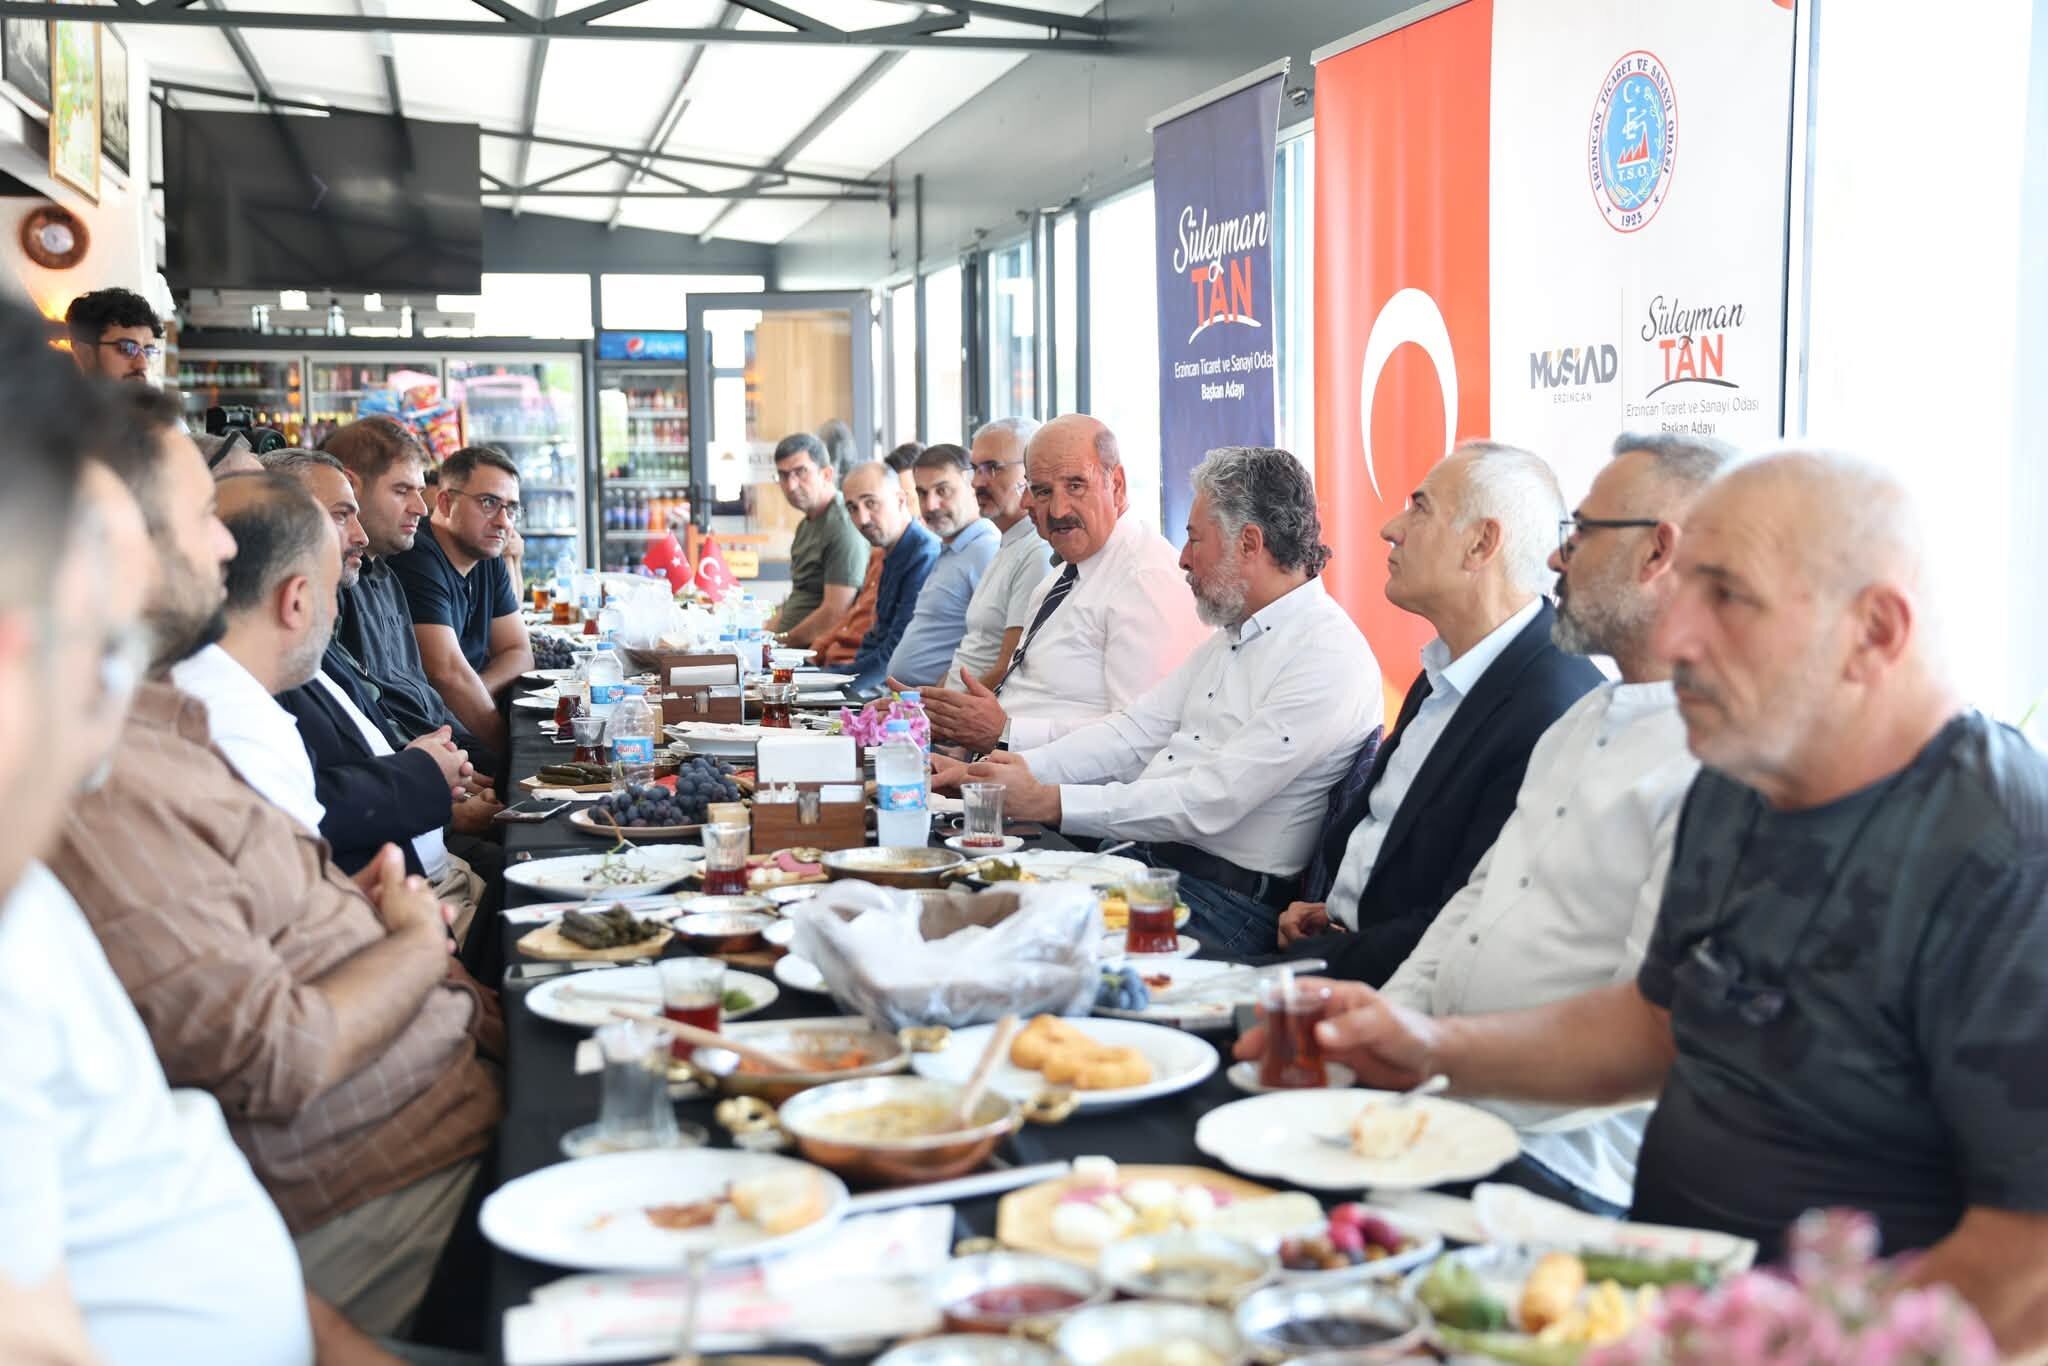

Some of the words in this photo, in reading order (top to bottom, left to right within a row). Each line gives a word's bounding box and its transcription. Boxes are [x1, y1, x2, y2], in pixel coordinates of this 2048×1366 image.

[1637, 58, 1649, 72] VE
[1663, 119, 1674, 174] ODASI
[1174, 205, 1268, 282] Süleyman
[1191, 255, 1254, 327] TAN
[1641, 295, 1746, 350] Süleyman
[1174, 361, 1199, 379] Erzincan
[1200, 356, 1222, 376] Ticaret
[1222, 360, 1231, 373] ve
[1232, 351, 1254, 376] Sanayi
[1659, 334, 1724, 382] TAN
[1201, 382, 1224, 402] Başkan
[1224, 379, 1245, 400] Adayı
[1626, 402, 1659, 417] Erzincan
[1661, 399, 1686, 416] Ticaret
[1688, 401, 1699, 414] ve
[1701, 397, 1730, 416] Sanayi
[1732, 396, 1760, 413] Odası
